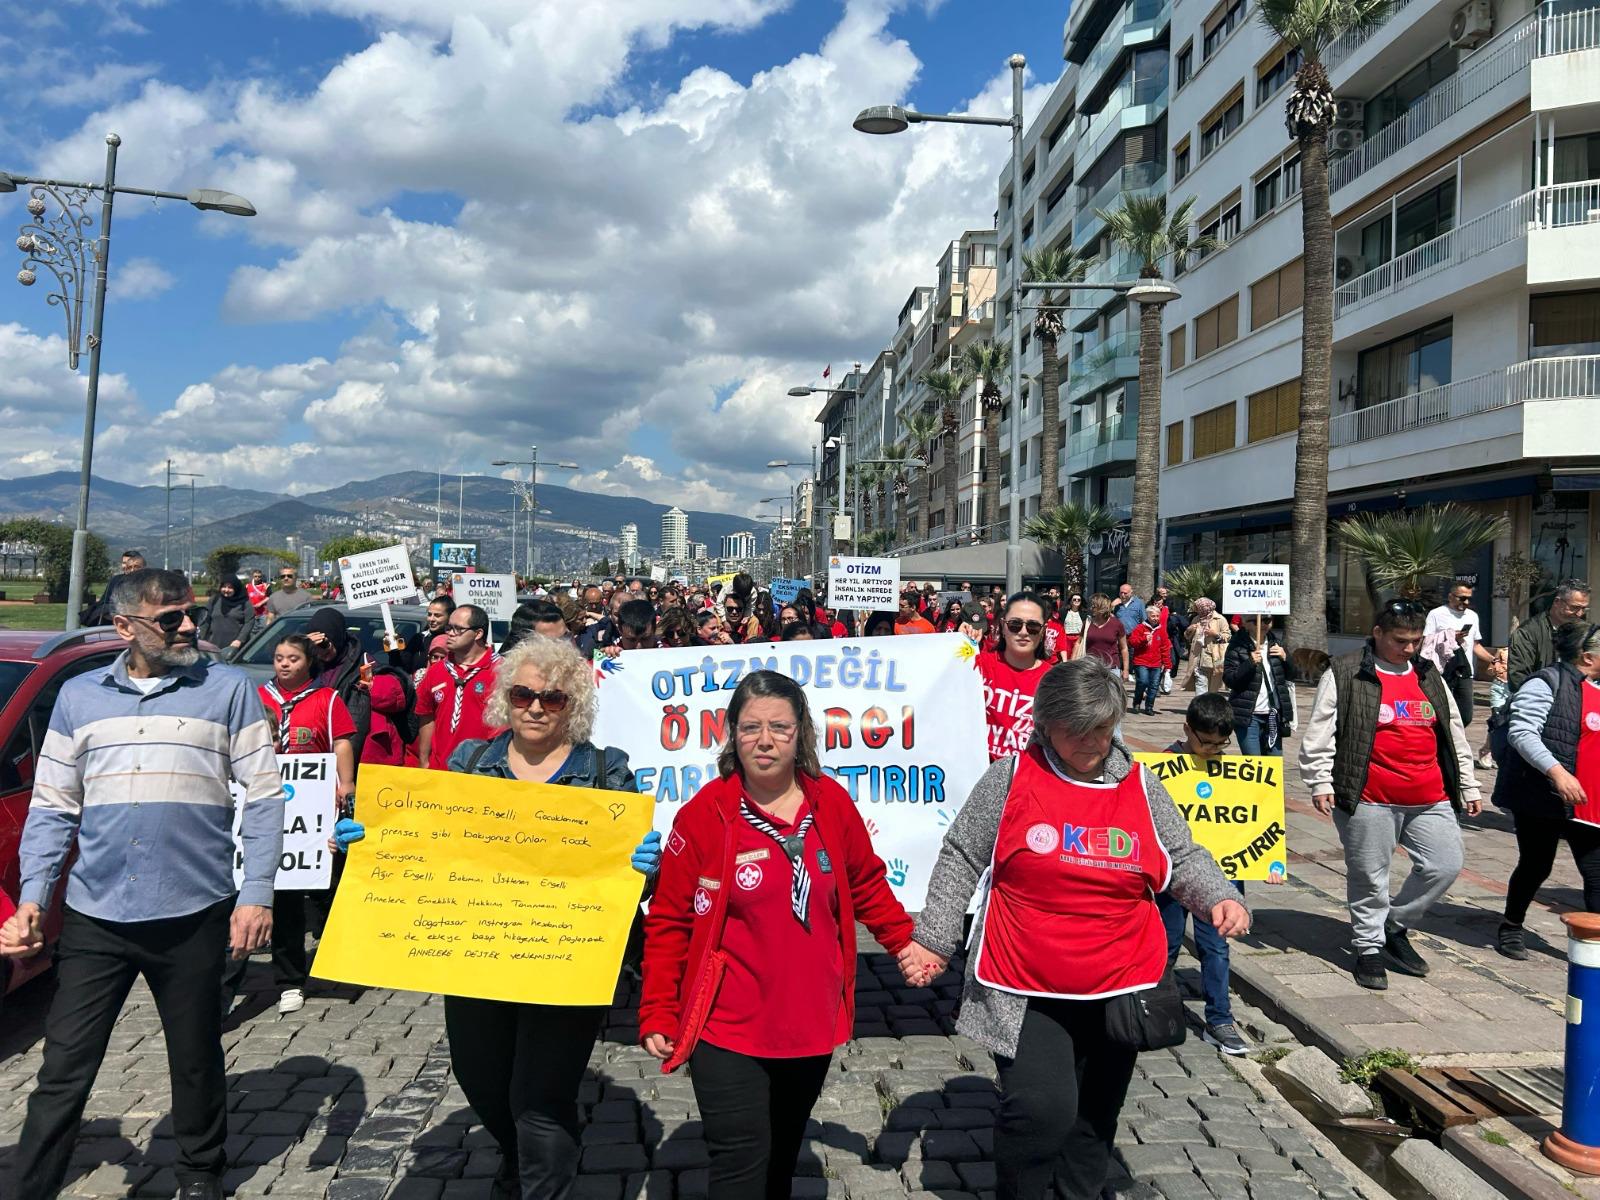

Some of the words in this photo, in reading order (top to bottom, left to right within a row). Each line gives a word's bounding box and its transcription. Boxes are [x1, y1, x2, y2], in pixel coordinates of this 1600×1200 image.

[359, 560, 377, 569] ERKEN
[377, 557, 390, 566] TANI
[847, 563, 881, 574] OTİZM
[352, 568, 375, 579] KALİTELİ
[376, 564, 400, 574] EĞİTİMLE
[351, 578, 379, 591] ÇOCUK
[382, 572, 406, 584] BÜYÜR
[469, 577, 500, 588] OTİZM
[862, 578, 893, 586] ARTIYOR
[1230, 578, 1284, 586] BAŞARABİLİR
[353, 589, 378, 599] OTİZM
[1234, 587, 1283, 598] OTİZMLİYE
[473, 598, 499, 606] SEÇİMİ
[856, 595, 893, 603] YAPIYOR
[789, 646, 908, 692] DEĞİL
[1394, 700, 1437, 720] KED
[1206, 758, 1277, 787] DEĞİL
[482, 805, 517, 820] Engelli
[380, 828, 419, 843] prenses
[370, 866, 394, 880] Ağır
[403, 869, 434, 881] Engelli
[540, 878, 567, 889] Engelli
[404, 931, 419, 941] de
[408, 947, 454, 958] ANNELERE
[464, 950, 500, 960] DESTEK
